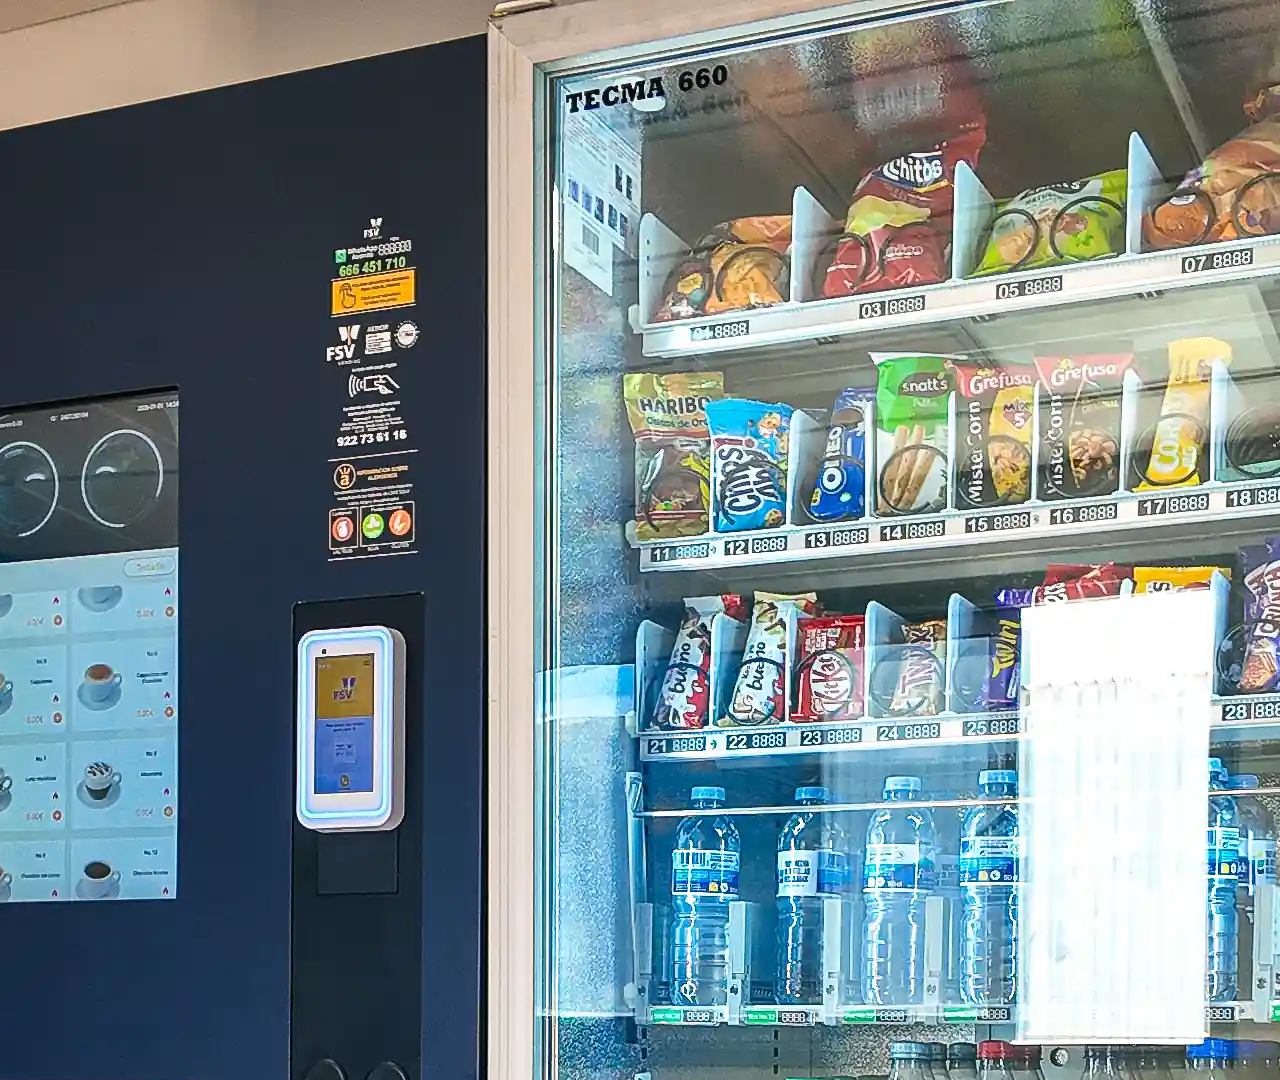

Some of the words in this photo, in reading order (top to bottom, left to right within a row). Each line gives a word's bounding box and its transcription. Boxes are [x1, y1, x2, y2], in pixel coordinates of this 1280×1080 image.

[566, 76, 665, 113] TECMA
[678, 65, 728, 92] 660
[362, 261, 382, 273] 451
[386, 257, 406, 270] 710
[1184, 257, 1206, 272] 07
[998, 285, 1019, 298] 05
[861, 302, 882, 318] 03
[326, 344, 356, 361] FSV
[1051, 362, 1118, 386] Grefusa
[970, 373, 1031, 395] Grefusa
[337, 434, 358, 446] 922
[360, 433, 374, 444] 73
[969, 449, 983, 501] Miste
[1230, 492, 1250, 505] 18
[1143, 500, 1163, 515] 17
[1053, 511, 1073, 524] 16
[968, 518, 988, 531] 15
[883, 527, 902, 540] 14
[808, 534, 826, 547] 13
[654, 548, 670, 561] 11
[726, 542, 746, 555] 12
[1225, 705, 1248, 720] 28
[880, 727, 898, 740] 24
[966, 723, 986, 735] 25
[729, 736, 747, 748] 22
[803, 732, 821, 744] 23
[651, 740, 666, 753] 21
